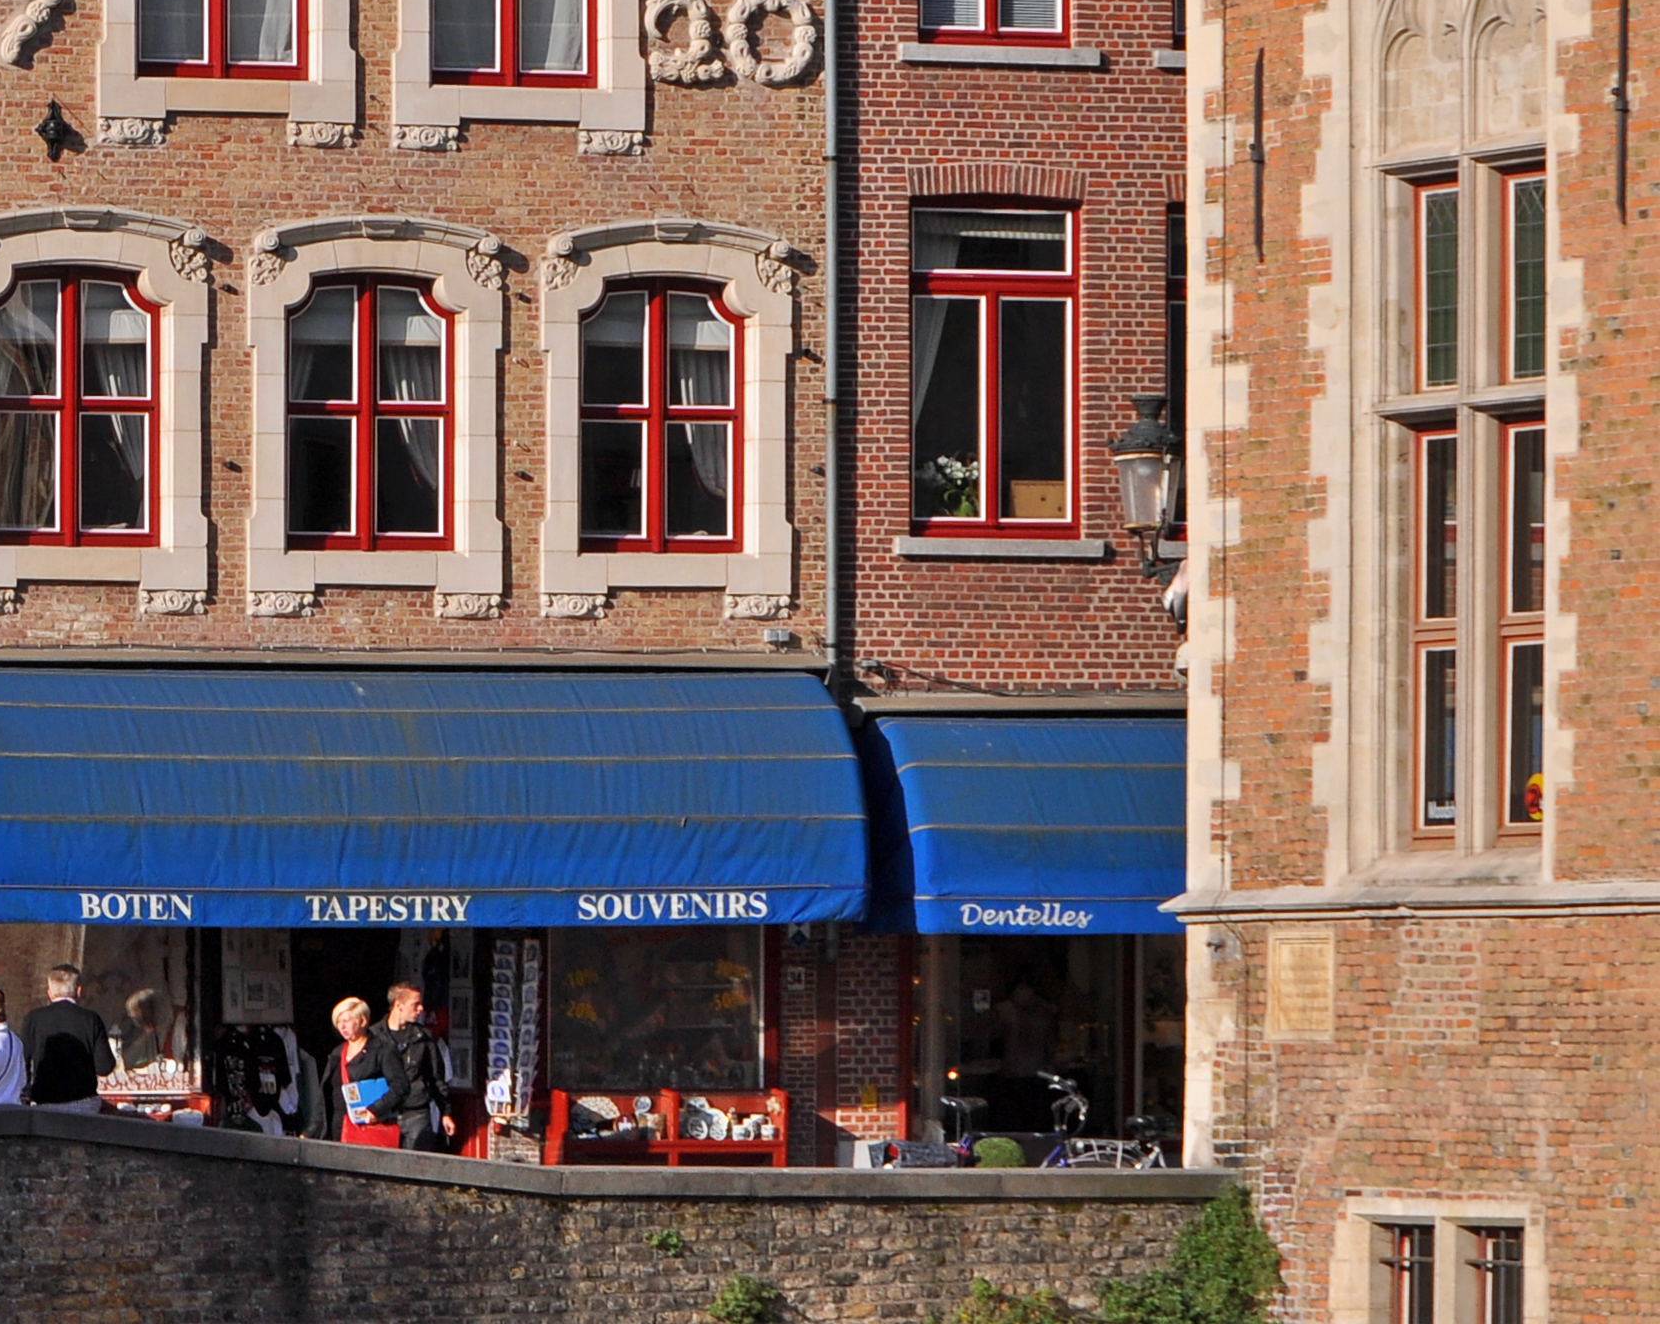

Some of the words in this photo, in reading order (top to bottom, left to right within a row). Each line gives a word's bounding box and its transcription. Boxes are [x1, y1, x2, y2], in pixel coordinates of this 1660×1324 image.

[78, 892, 195, 921] BOTEN
[304, 894, 472, 922] TAPESTRY
[577, 891, 769, 921] SOUVENIRS
[959, 902, 1094, 929] Dentelles
